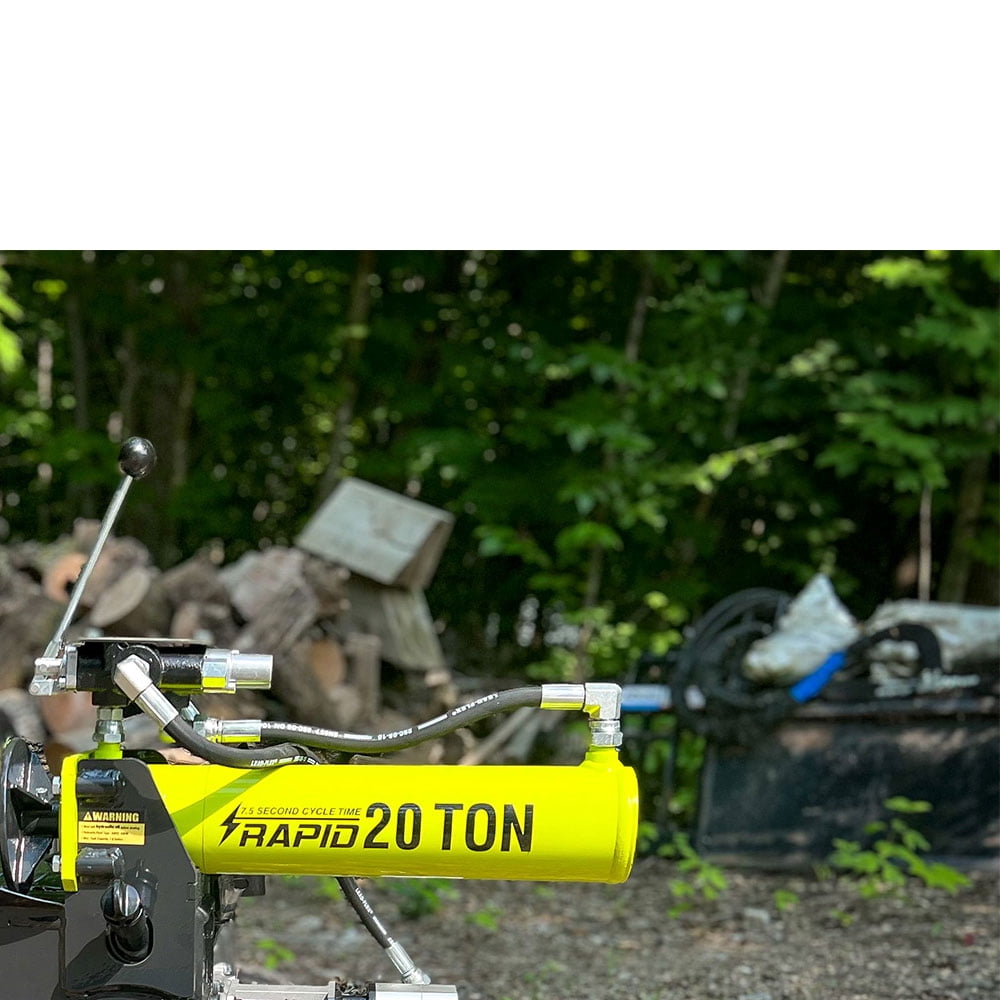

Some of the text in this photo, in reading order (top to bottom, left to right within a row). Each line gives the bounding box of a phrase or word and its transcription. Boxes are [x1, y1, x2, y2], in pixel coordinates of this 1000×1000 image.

[92, 811, 140, 822] WARNING
[240, 806, 362, 816] 7.5 SECOND CYCLE TIME
[238, 802, 534, 852] RAPID 20 TON
